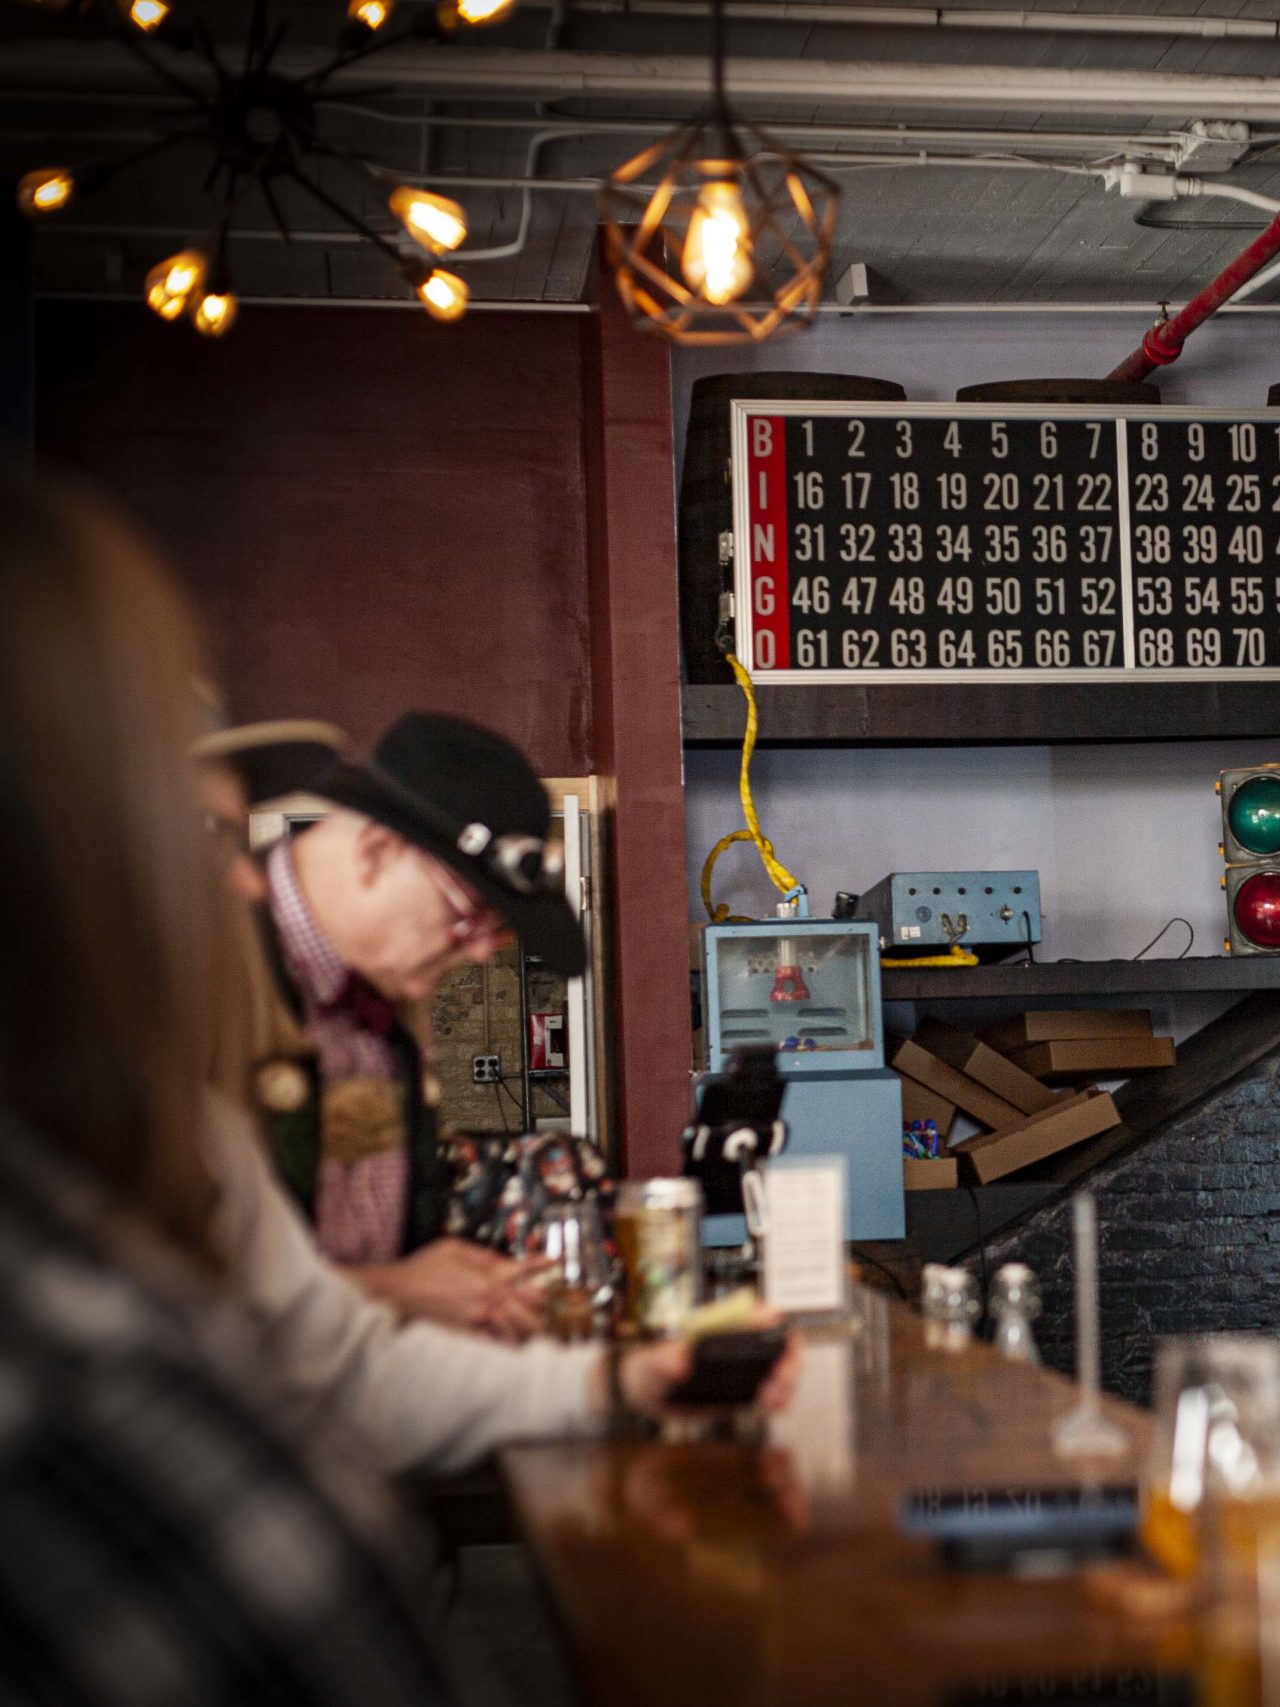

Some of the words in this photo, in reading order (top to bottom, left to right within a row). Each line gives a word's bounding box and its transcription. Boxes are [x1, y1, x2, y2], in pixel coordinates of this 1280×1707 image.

[802, 420, 814, 457] 1
[848, 419, 865, 457] 2
[896, 420, 913, 458] 3
[943, 421, 962, 458] 4
[991, 422, 1008, 459] 5
[1040, 421, 1057, 459] 6
[1086, 423, 1101, 459] 7
[1141, 422, 1159, 461] 8
[1187, 422, 1205, 462] 9
[1228, 422, 1257, 463] 10
[794, 471, 824, 510] 16
[841, 472, 872, 509] 17
[889, 471, 920, 510] 18
[936, 472, 967, 510] 19
[983, 472, 1019, 511] 20
[1033, 473, 1064, 511] 21
[1077, 473, 1112, 511] 22
[1135, 473, 1169, 512] 23
[1182, 473, 1215, 512] 24
[1226, 474, 1261, 513] 25
[795, 523, 825, 562] 31
[839, 523, 876, 562] 32
[888, 523, 923, 563] 33
[936, 524, 973, 563] 34
[984, 524, 1020, 563] 35
[1032, 524, 1067, 563] 36
[1079, 525, 1113, 563] 37
[1135, 524, 1171, 564] 38
[1182, 525, 1218, 564] 39
[1228, 524, 1263, 564] 40
[792, 575, 830, 614] 46
[841, 576, 877, 615] 47
[888, 576, 925, 615] 48
[936, 576, 974, 615] 49
[985, 577, 1021, 615] 50
[1035, 577, 1066, 616] 51
[1081, 577, 1116, 615] 52
[1137, 576, 1173, 616] 53
[1184, 576, 1221, 616] 54
[1230, 577, 1264, 615] 55
[797, 628, 828, 668] 61
[842, 629, 880, 668] 62
[890, 628, 927, 668] 63
[938, 628, 977, 668] 64
[987, 628, 1023, 668] 65
[1034, 628, 1071, 668] 66
[1082, 628, 1117, 668] 67
[1137, 627, 1175, 668] 68
[1185, 627, 1222, 668] 69
[1232, 627, 1266, 667] 70
